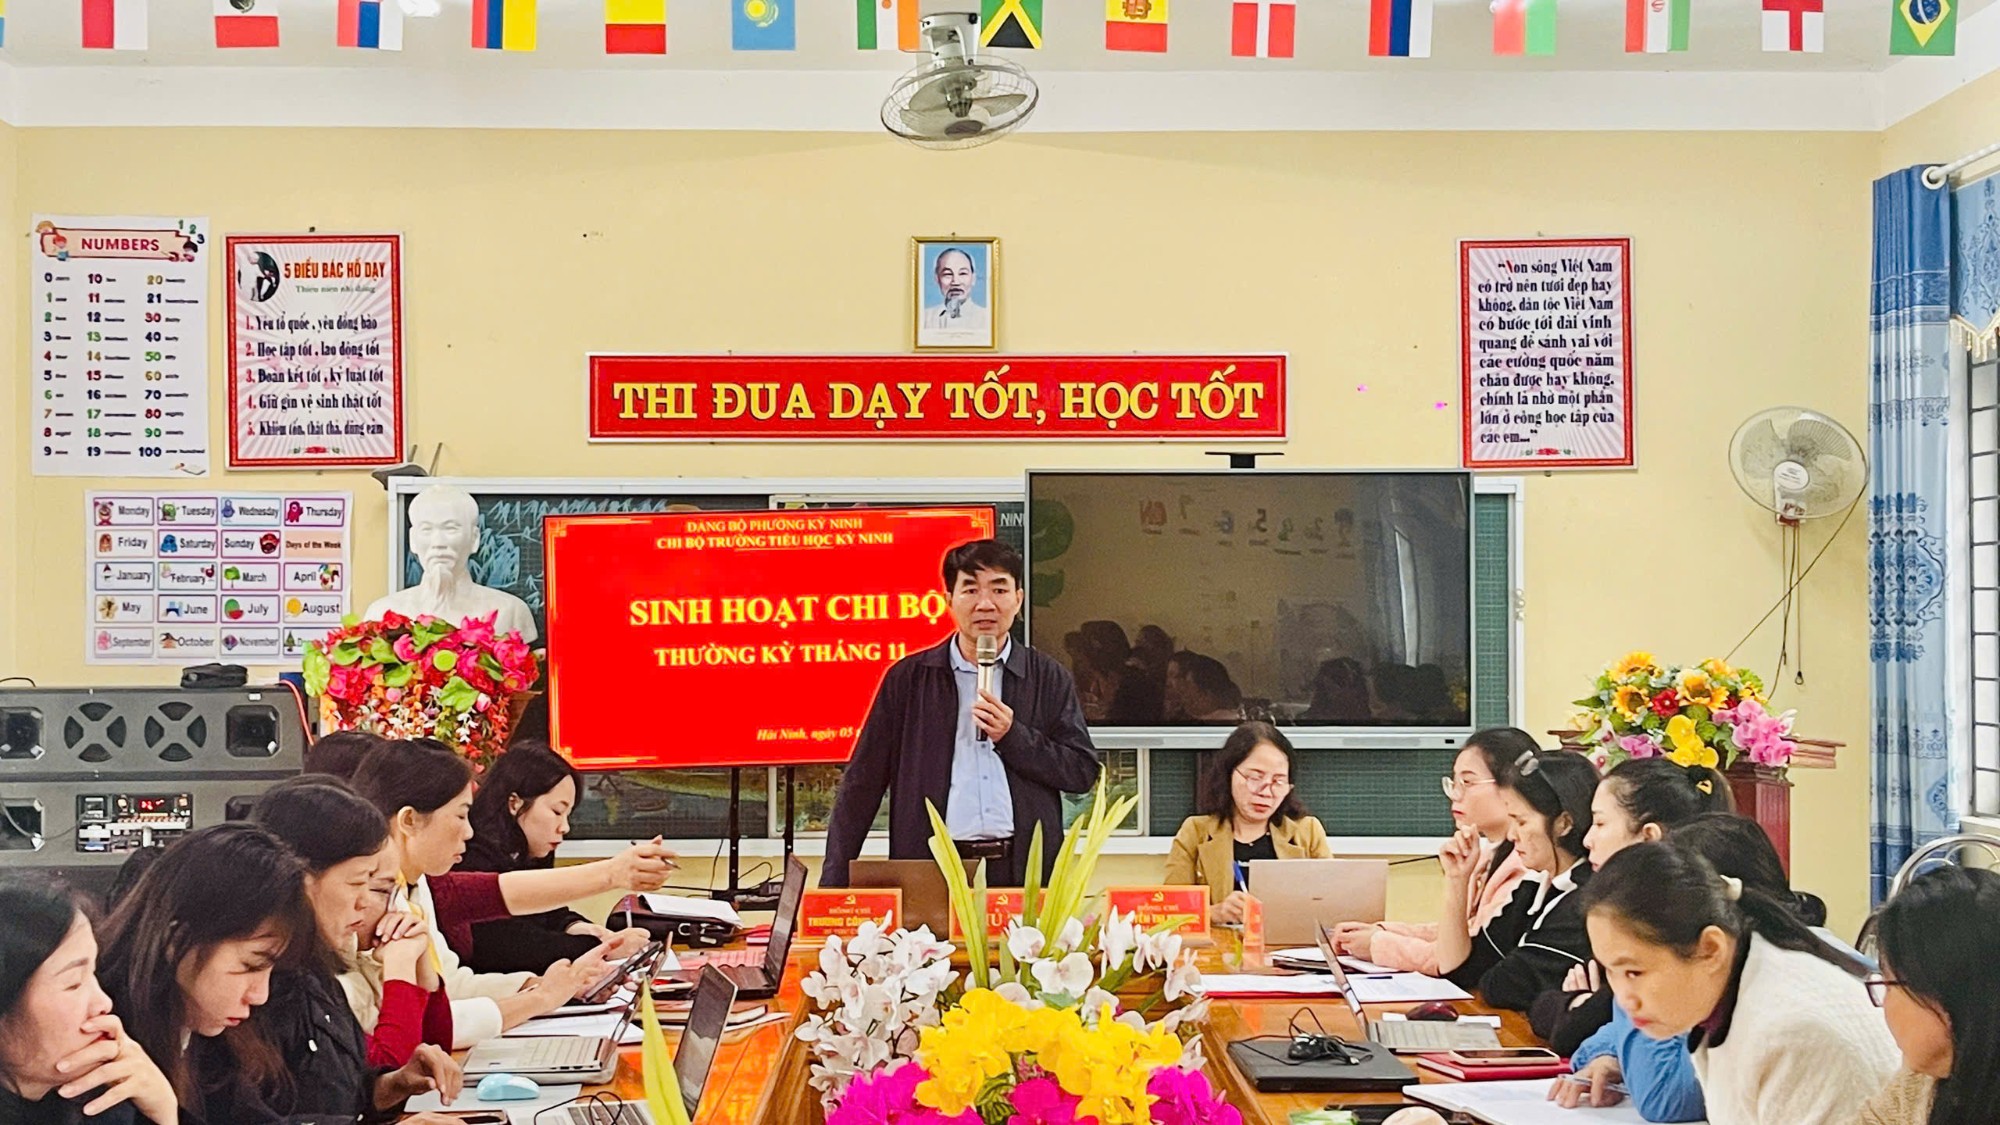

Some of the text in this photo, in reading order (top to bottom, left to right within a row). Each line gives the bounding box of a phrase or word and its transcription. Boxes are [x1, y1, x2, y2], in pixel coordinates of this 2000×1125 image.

[81, 238, 160, 251] NUMBERS
[284, 259, 385, 281] 5 BÁC DẠY
[1531, 260, 1557, 276] sông
[1588, 259, 1613, 272] Nam
[44, 272, 53, 282] 0
[88, 273, 103, 284] 10
[147, 275, 163, 285] 20
[1478, 279, 1492, 293] có
[1516, 279, 1538, 292] nên
[1541, 278, 1564, 292] tươi
[46, 292, 52, 303] 1
[88, 293, 100, 303] 11
[147, 293, 162, 304] 21
[1589, 296, 1613, 310] Nam
[45, 311, 52, 322] 2
[87, 311, 101, 322] 12
[145, 312, 162, 323] 30
[1479, 316, 1494, 330] có
[1498, 316, 1530, 330] bước
[1535, 315, 1552, 330] tới
[44, 331, 52, 342] 3
[87, 331, 102, 342] 13
[145, 331, 162, 342] 40
[321, 341, 336, 356] lao
[1479, 337, 1517, 353] quang
[1538, 334, 1567, 348] sánh
[1571, 334, 1590, 348] vai
[1594, 333, 1613, 347] với
[44, 350, 52, 361] 4
[87, 350, 102, 361] 14
[145, 351, 162, 362] 50
[1479, 354, 1501, 368] các
[1550, 350, 1582, 371] quốc
[1586, 352, 1614, 366] năm
[44, 370, 52, 381] 5
[87, 370, 102, 381] 15
[145, 371, 162, 381] 60
[45, 390, 52, 400] 6
[87, 389, 101, 400] 16
[145, 390, 162, 400] 70
[613, 364, 1264, 429] THI ĐUA DẠY TỐT, HỌC TỐT
[1480, 391, 1513, 406] chính
[316, 393, 339, 408] sinh
[44, 408, 52, 419] 7
[87, 408, 101, 419] 17
[145, 408, 162, 419] 80
[1480, 410, 1499, 424] lớn
[44, 427, 52, 437] 8
[87, 427, 101, 438] 18
[144, 428, 162, 438] 90
[1480, 429, 1500, 443] các
[44, 446, 52, 456] 9
[87, 446, 101, 457] 19
[139, 446, 162, 457] 100
[118, 506, 150, 518] Monday
[182, 505, 216, 518] Tuesday
[238, 506, 279, 519] Wednesday
[306, 506, 343, 519] Thursday
[728, 518, 747, 533] BỘ
[830, 518, 862, 530] NINH
[118, 536, 148, 549] Friday
[180, 537, 216, 551] Saturday
[224, 538, 255, 550] Sunday
[286, 540, 342, 550] Days of the Week
[657, 538, 682, 549] CHI
[686, 536, 705, 550] BỘ
[708, 534, 766, 548] TRƯỜNG
[803, 534, 833, 548] HỌC
[859, 532, 893, 545] NINH
[116, 570, 152, 583] January
[171, 573, 206, 585] February
[242, 572, 267, 583] March
[293, 571, 317, 583] April
[122, 603, 142, 614] May
[184, 604, 208, 615] June
[248, 603, 269, 616] July
[302, 603, 340, 616] August
[630, 590, 947, 629] SINH HOẠT CHI BỘ
[113, 637, 153, 649] September
[178, 637, 214, 648] October
[239, 637, 279, 647] November
[654, 638, 906, 666] THƯỜNG KỲ THÁNG 11
[839, 726, 853, 738] 05
